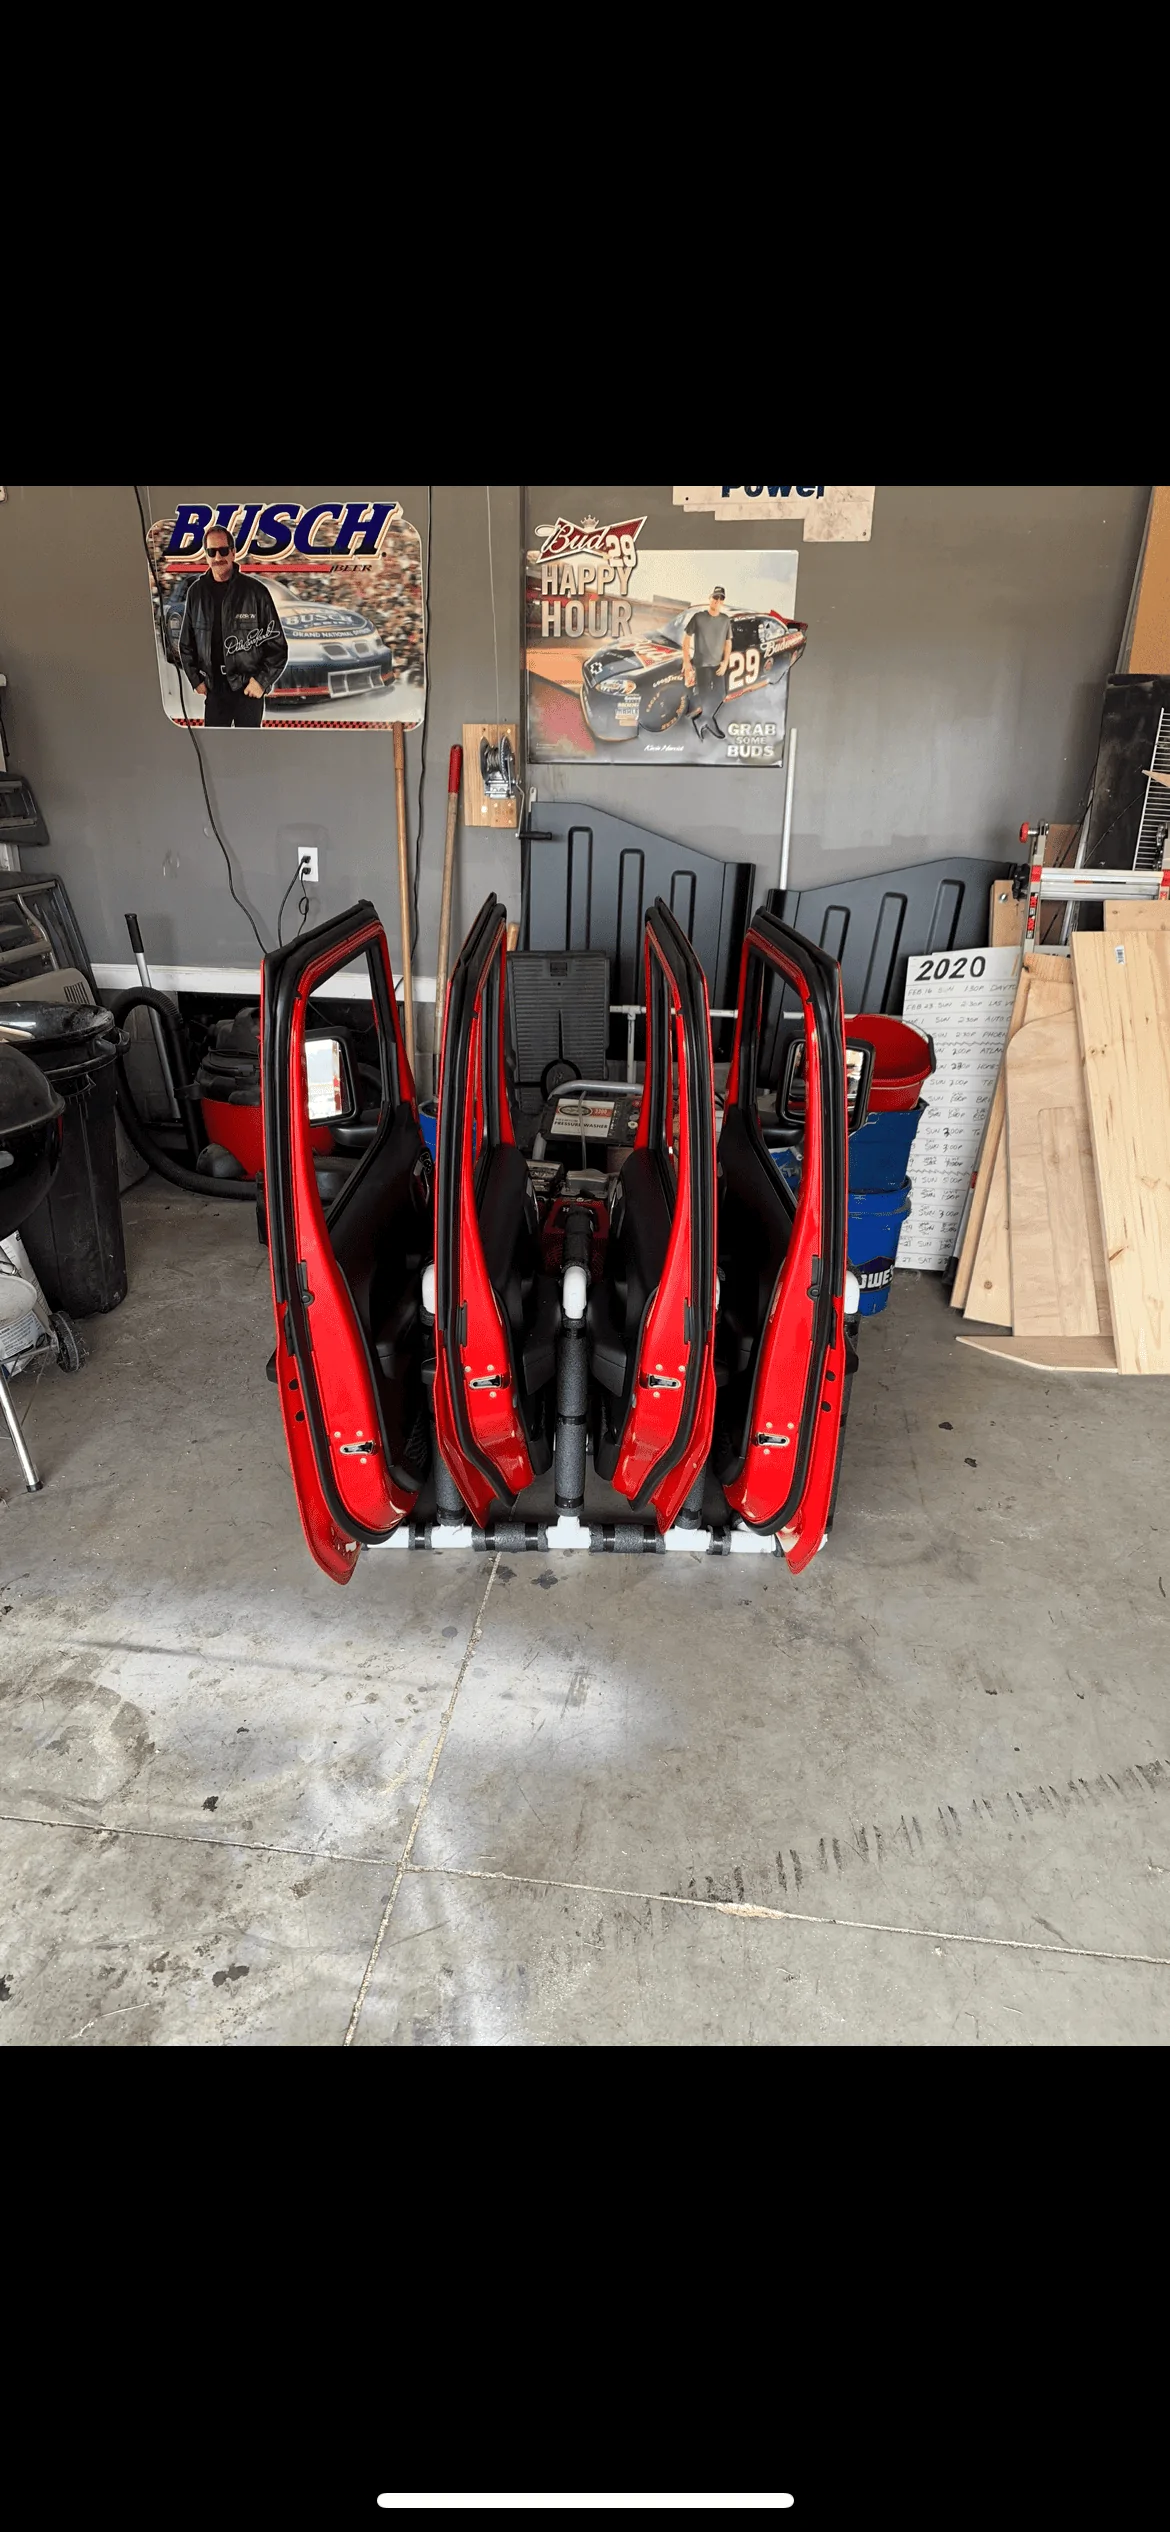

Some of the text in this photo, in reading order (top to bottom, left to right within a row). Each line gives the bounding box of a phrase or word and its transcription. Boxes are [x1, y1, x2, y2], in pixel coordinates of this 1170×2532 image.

[160, 502, 401, 560] BUSCH
[535, 524, 611, 554] Bud
[605, 534, 637, 568] 29
[332, 564, 373, 573] BEER
[541, 564, 634, 596] HAPPY
[286, 614, 353, 626] BUSCH
[541, 599, 633, 638] HOUR
[728, 648, 761, 690] 29
[727, 723, 777, 736] GRAB
[736, 736, 767, 744] SOME
[727, 745, 775, 758] BUDS
[914, 956, 986, 982] 2020
[917, 1240, 932, 1248] SUN
[917, 1256, 933, 1264] SAT
